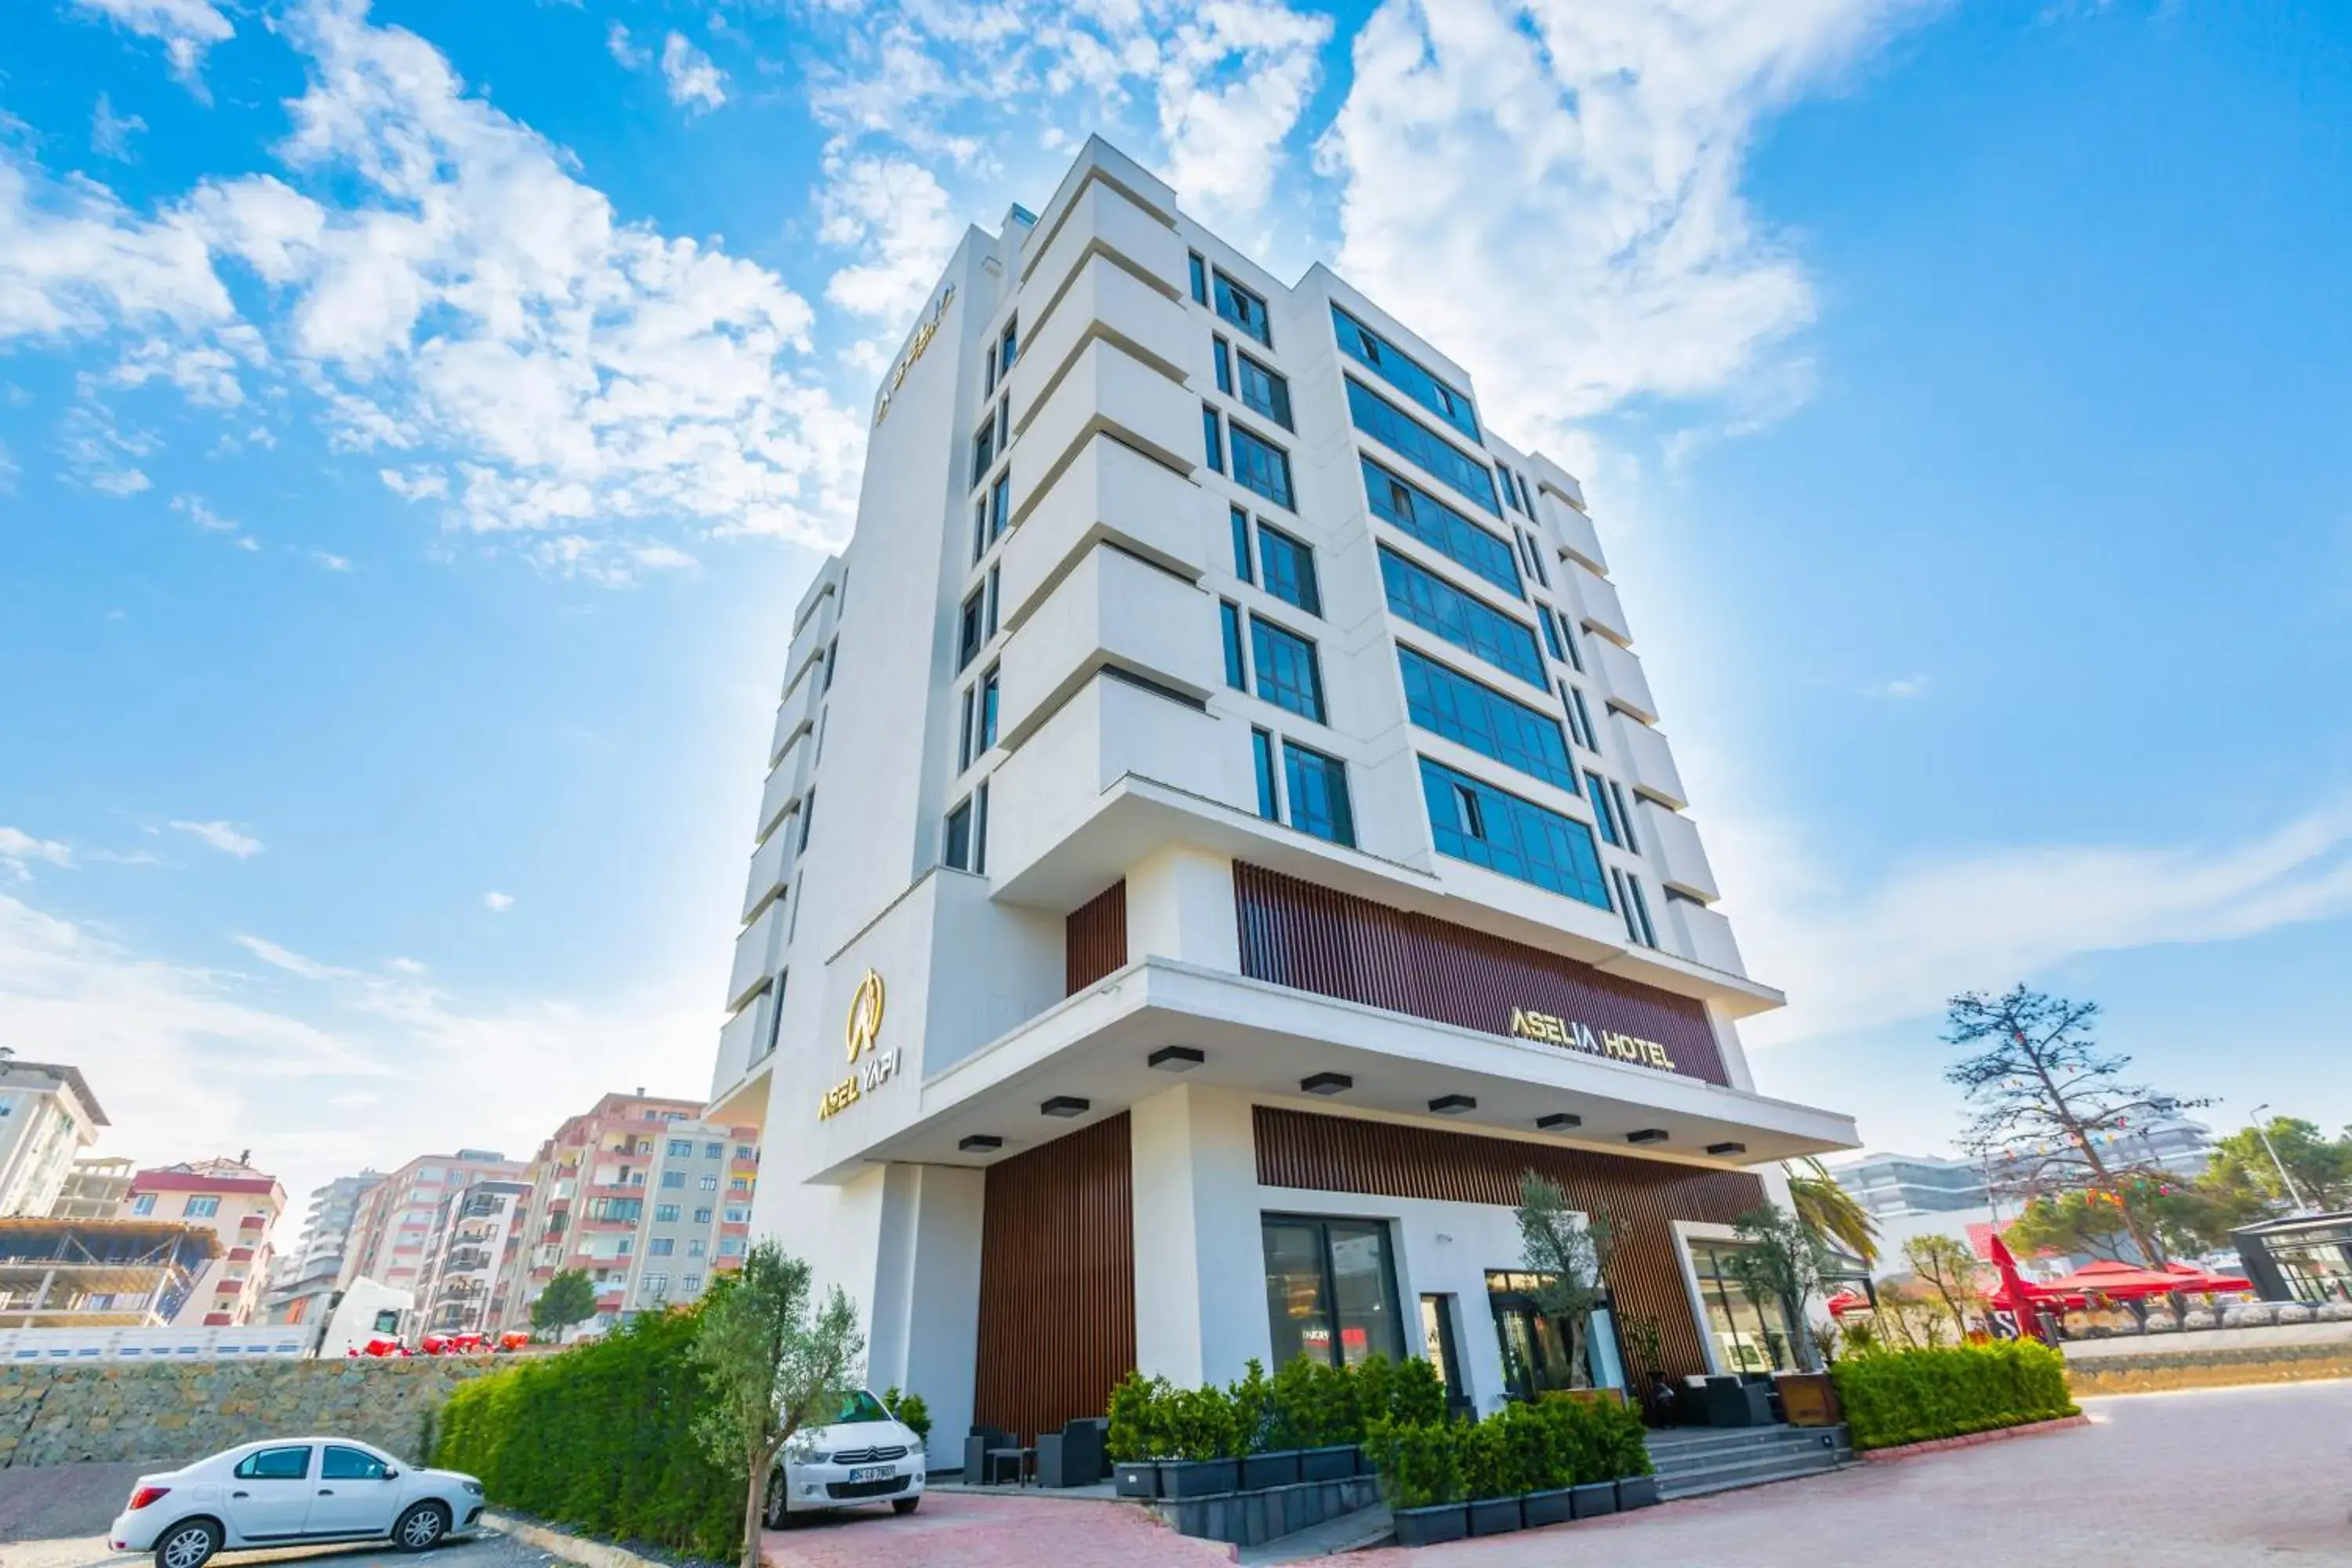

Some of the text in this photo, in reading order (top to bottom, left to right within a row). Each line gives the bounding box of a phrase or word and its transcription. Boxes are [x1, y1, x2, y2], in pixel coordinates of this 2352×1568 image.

[1600, 1029, 1675, 1069] HOTEL
[818, 1046, 902, 1123] ASEL YAPI
